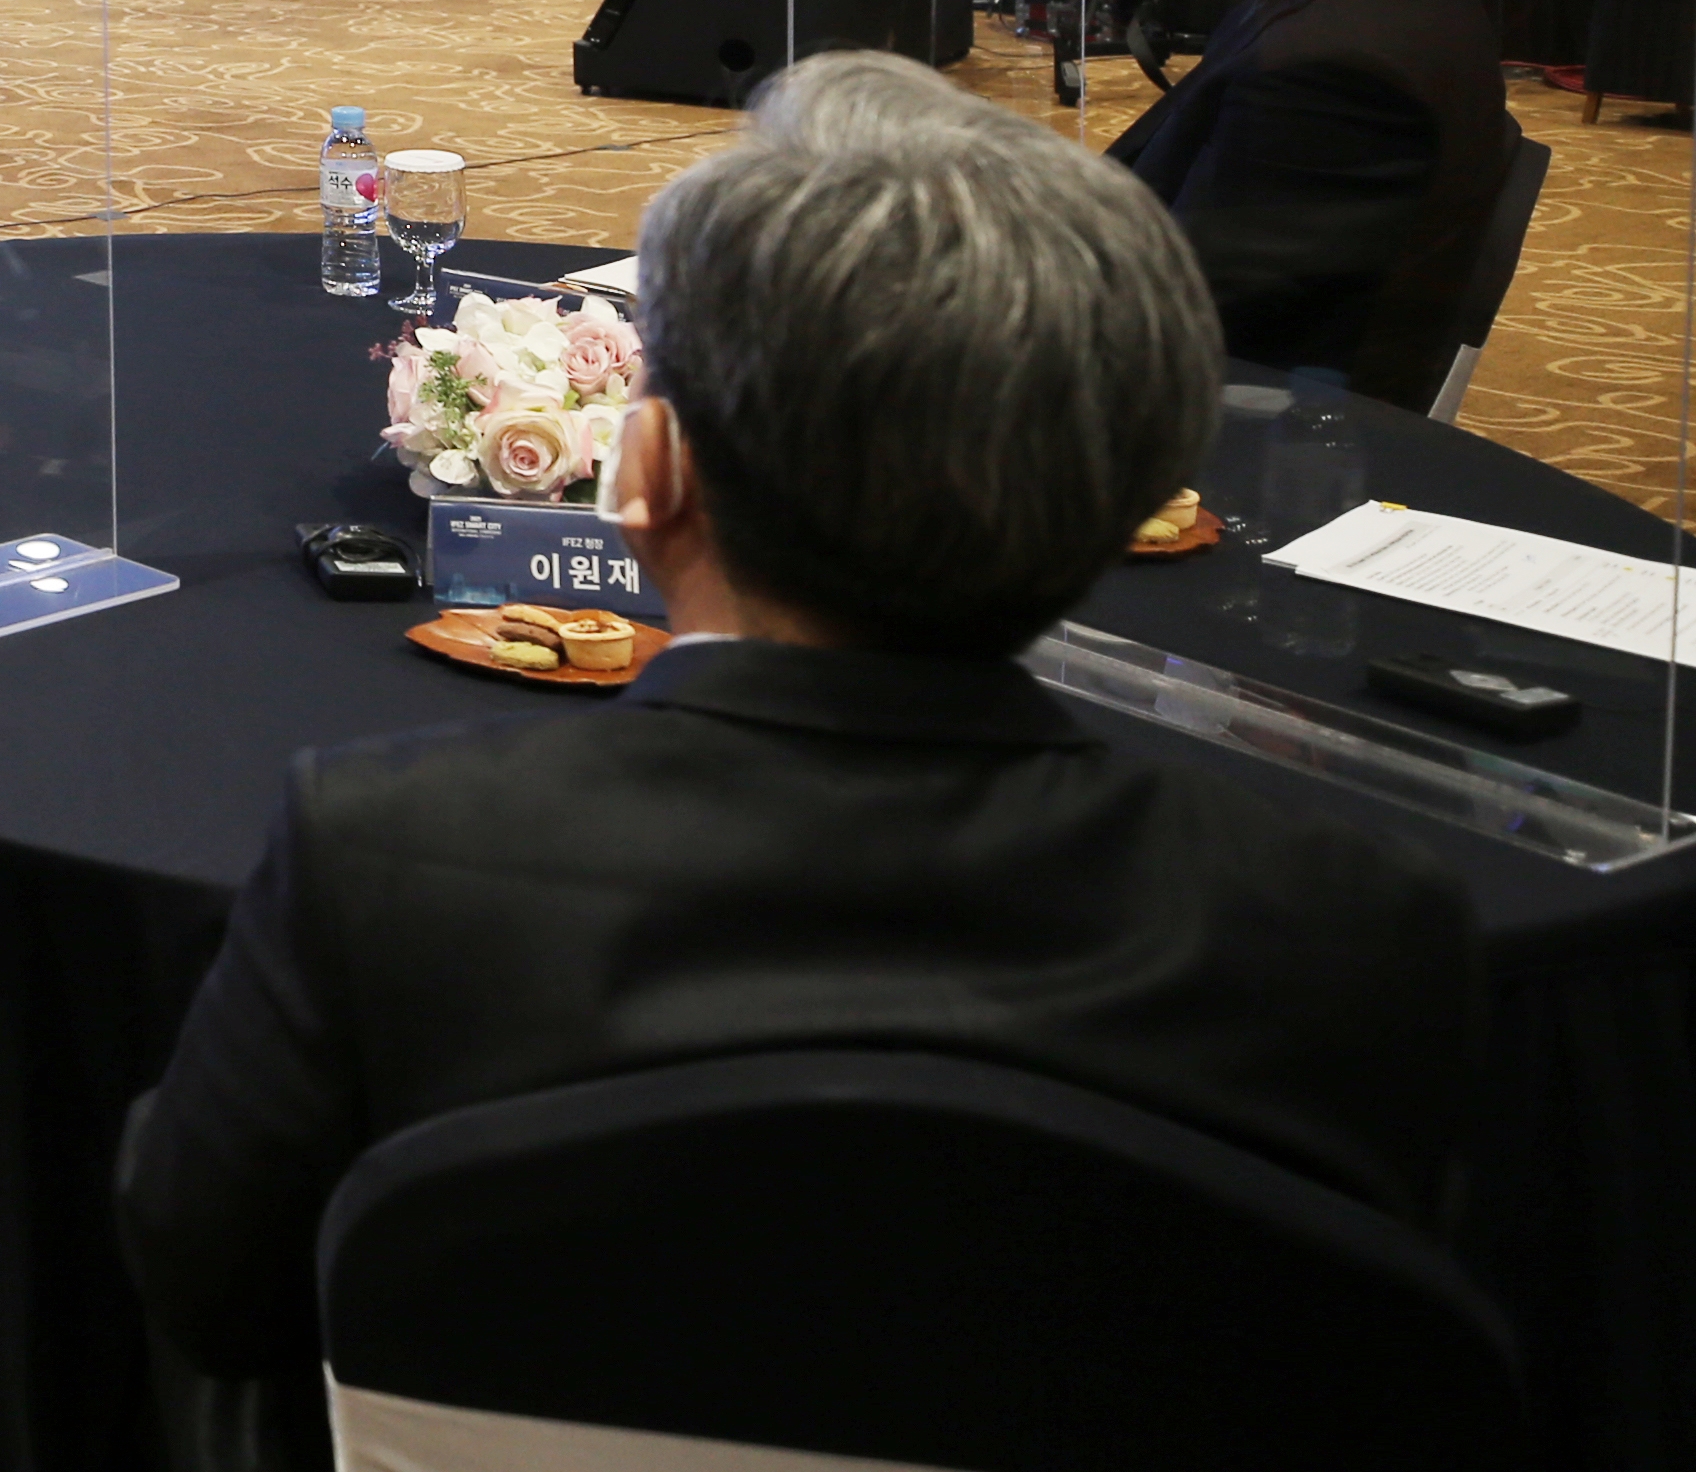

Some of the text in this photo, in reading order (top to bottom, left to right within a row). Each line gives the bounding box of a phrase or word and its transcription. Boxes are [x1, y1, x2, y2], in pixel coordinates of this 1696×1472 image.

[328, 174, 353, 190] 석수
[562, 536, 583, 548] IFEZ
[530, 552, 641, 595] 이원재
